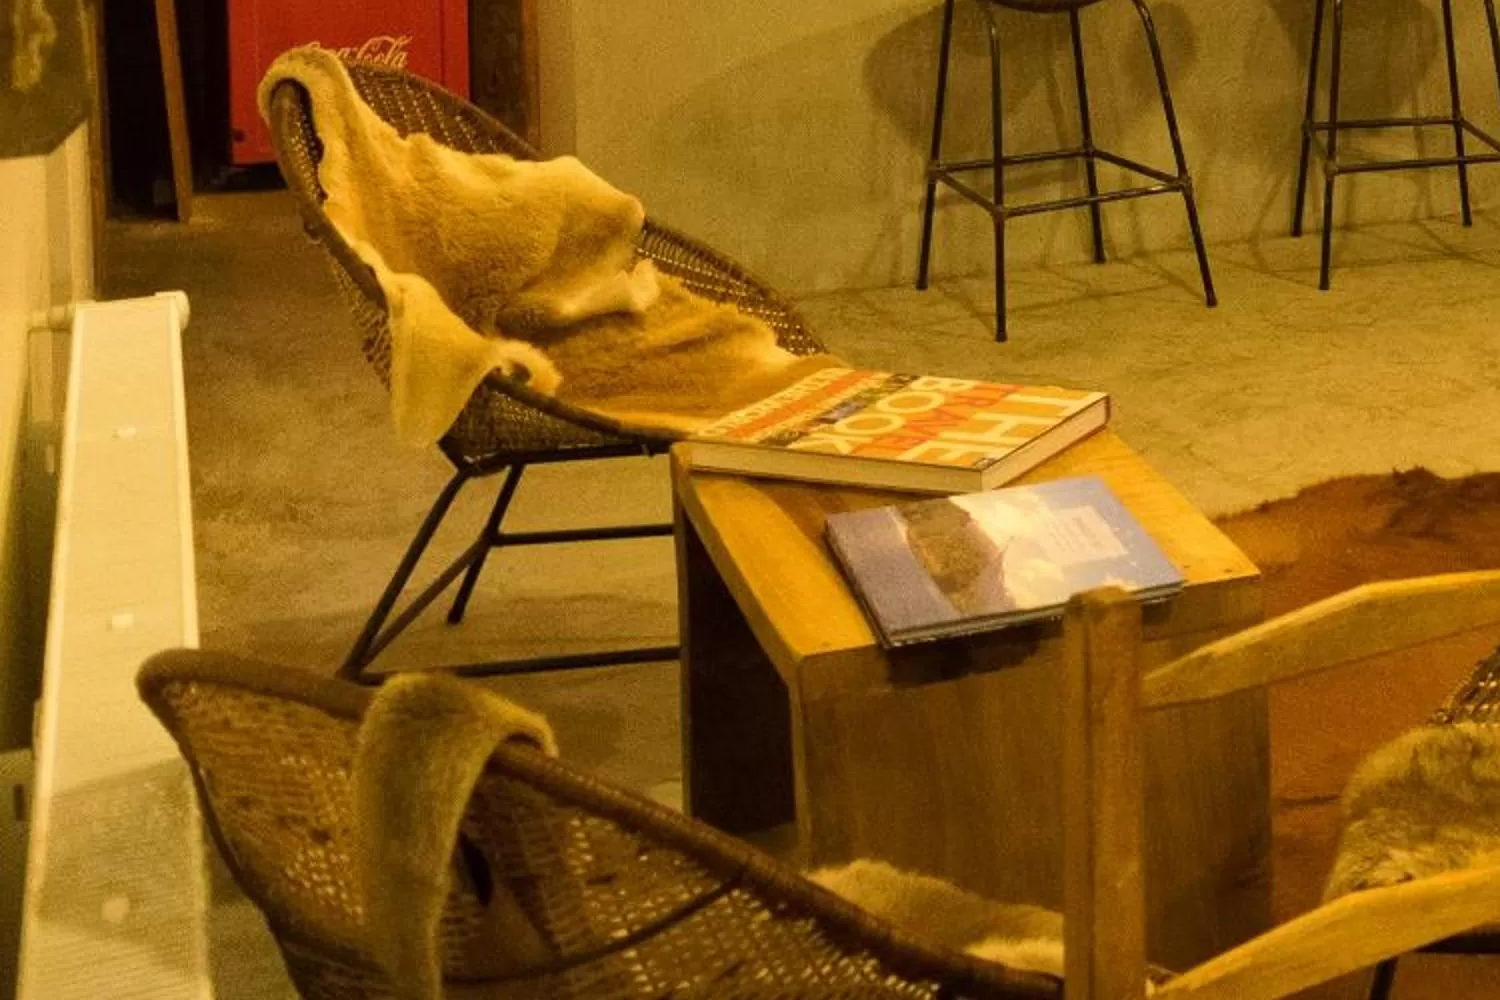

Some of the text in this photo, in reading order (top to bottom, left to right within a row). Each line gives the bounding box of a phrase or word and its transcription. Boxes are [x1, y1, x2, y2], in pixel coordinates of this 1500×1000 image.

[786, 375, 979, 456] BOOK
[842, 383, 1025, 460] TRAVEL
[895, 391, 1109, 463] THE
